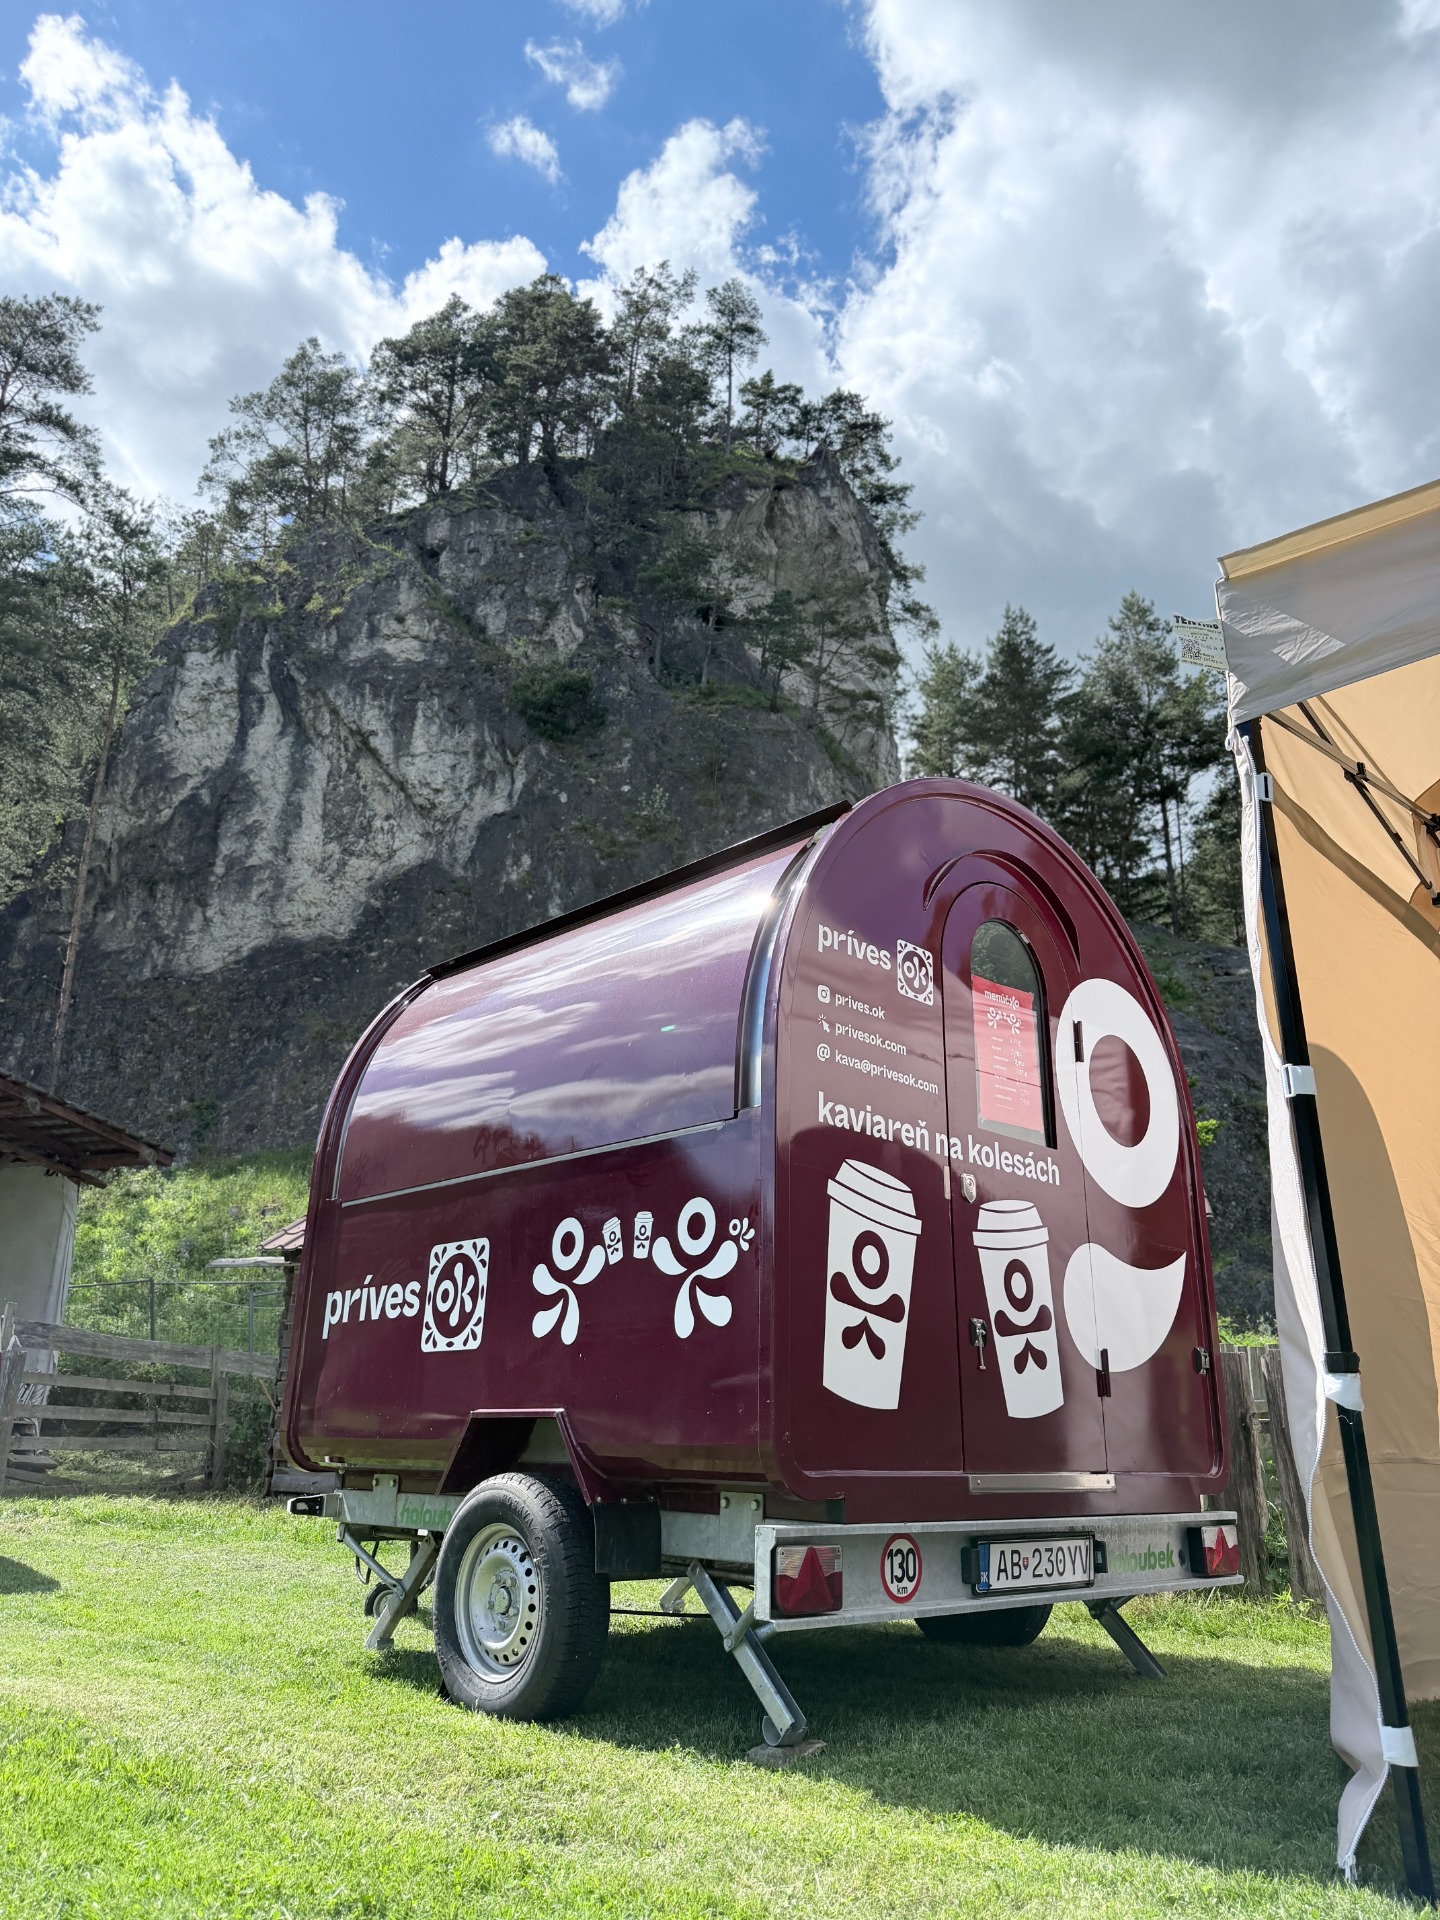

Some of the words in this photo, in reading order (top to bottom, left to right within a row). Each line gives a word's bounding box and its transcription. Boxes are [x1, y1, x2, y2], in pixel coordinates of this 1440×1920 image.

[818, 924, 892, 971] príves
[835, 991, 885, 1020] prives.ok
[835, 1021, 907, 1056] privesok.com
[835, 1050, 939, 1095] kava@privesok.com
[818, 1090, 930, 1151] kaviareň
[935, 1130, 963, 1161] na
[968, 1134, 1061, 1186] kolesách
[322, 1273, 421, 1340] príves
[400, 1496, 453, 1528] holoub
[887, 1547, 917, 1585] 130
[996, 1550, 1022, 1582] AB
[1032, 1544, 1089, 1578] 230YV
[897, 1584, 908, 1595] km
